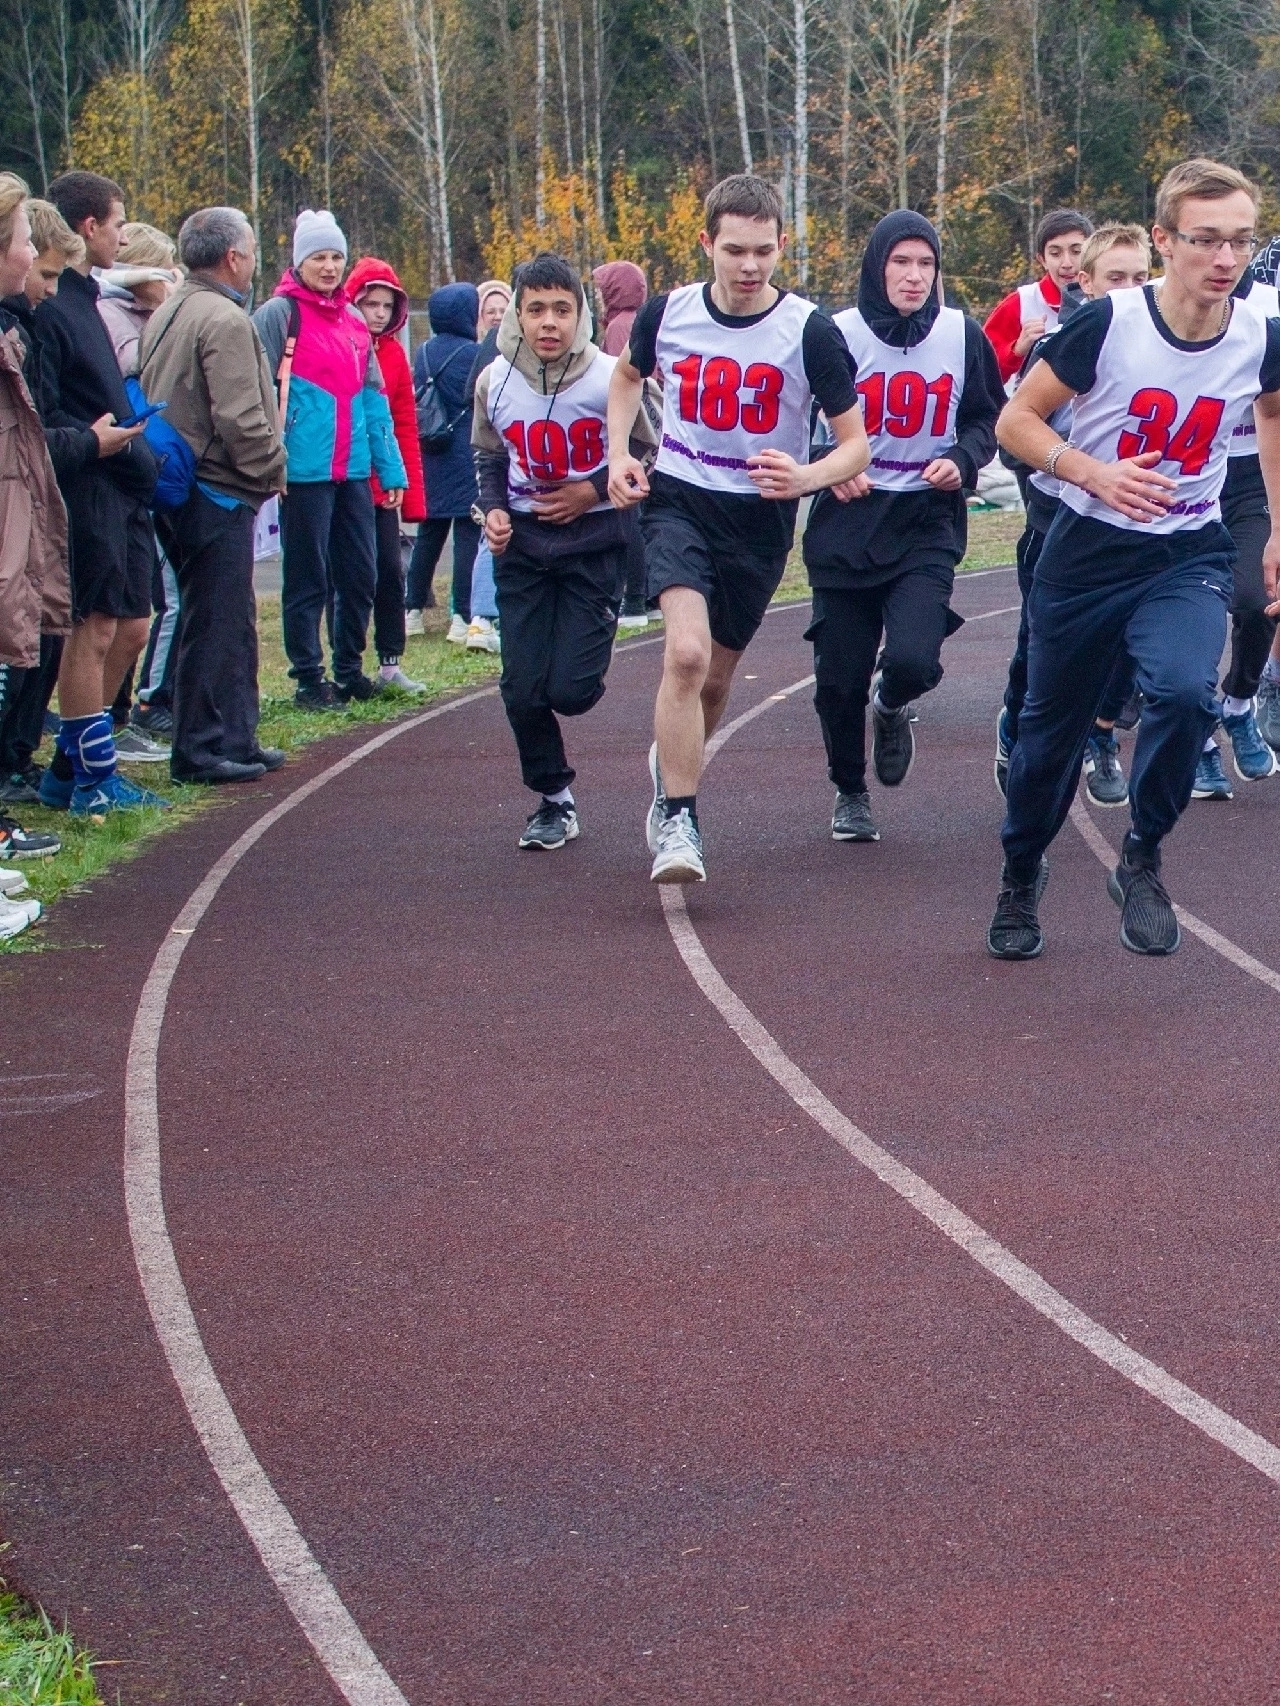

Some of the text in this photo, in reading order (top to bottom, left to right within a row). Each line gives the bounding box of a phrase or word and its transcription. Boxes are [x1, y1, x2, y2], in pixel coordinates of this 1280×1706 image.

[672, 354, 784, 434] 183
[855, 371, 953, 438] 191
[503, 417, 604, 481] 198
[1117, 388, 1226, 476] 34
